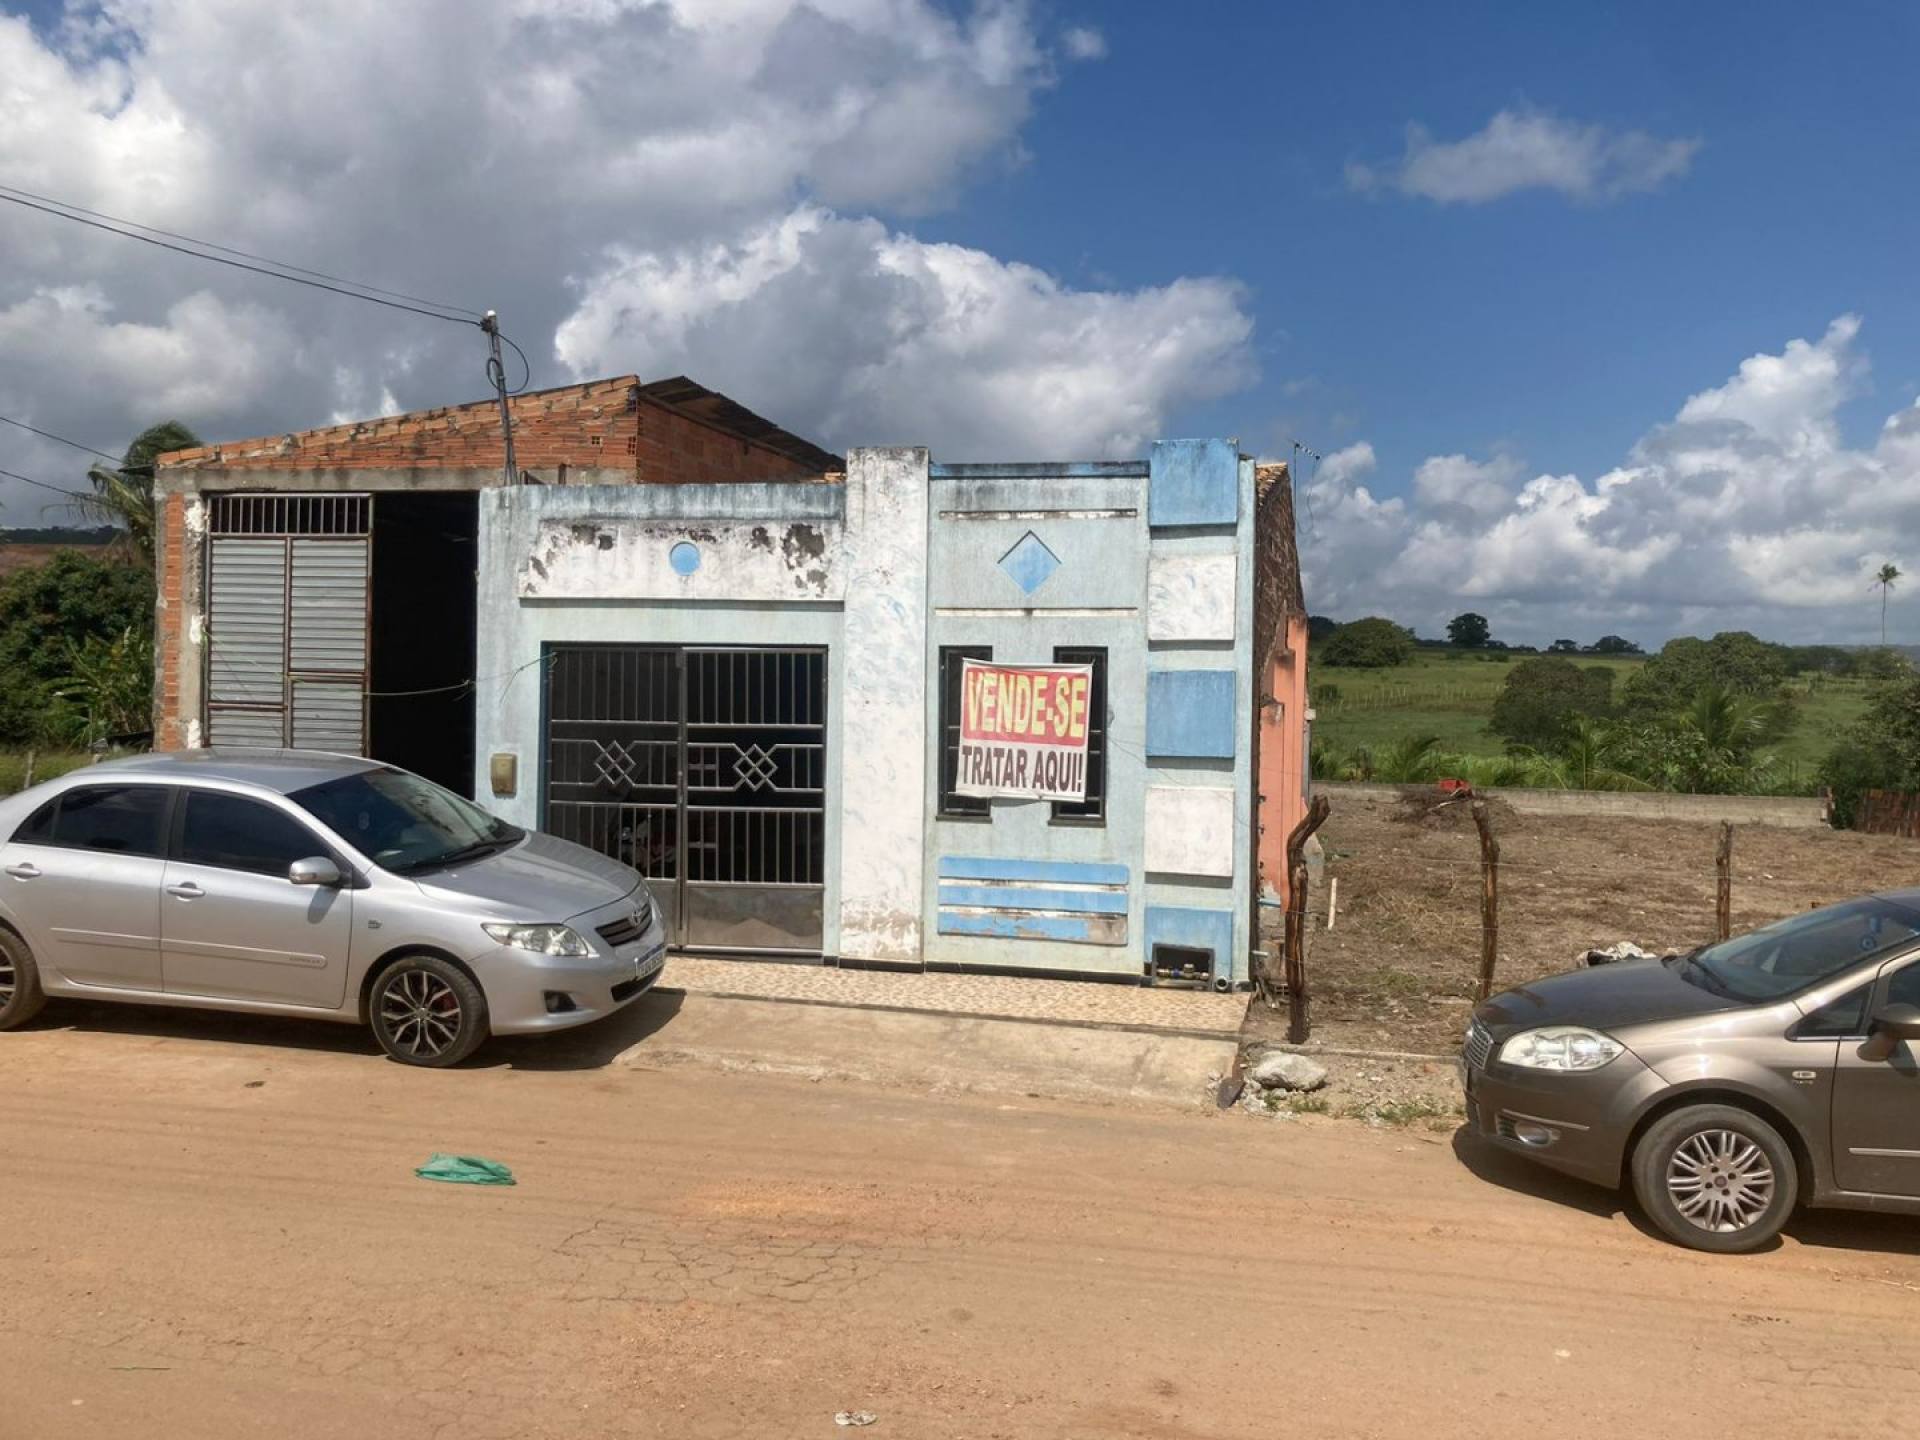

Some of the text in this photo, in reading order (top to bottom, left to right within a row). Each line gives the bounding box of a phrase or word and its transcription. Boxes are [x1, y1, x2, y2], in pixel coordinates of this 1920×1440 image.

[967, 671, 1087, 738] VENDE-SE
[962, 745, 1083, 793] TRATAR AQUI!
